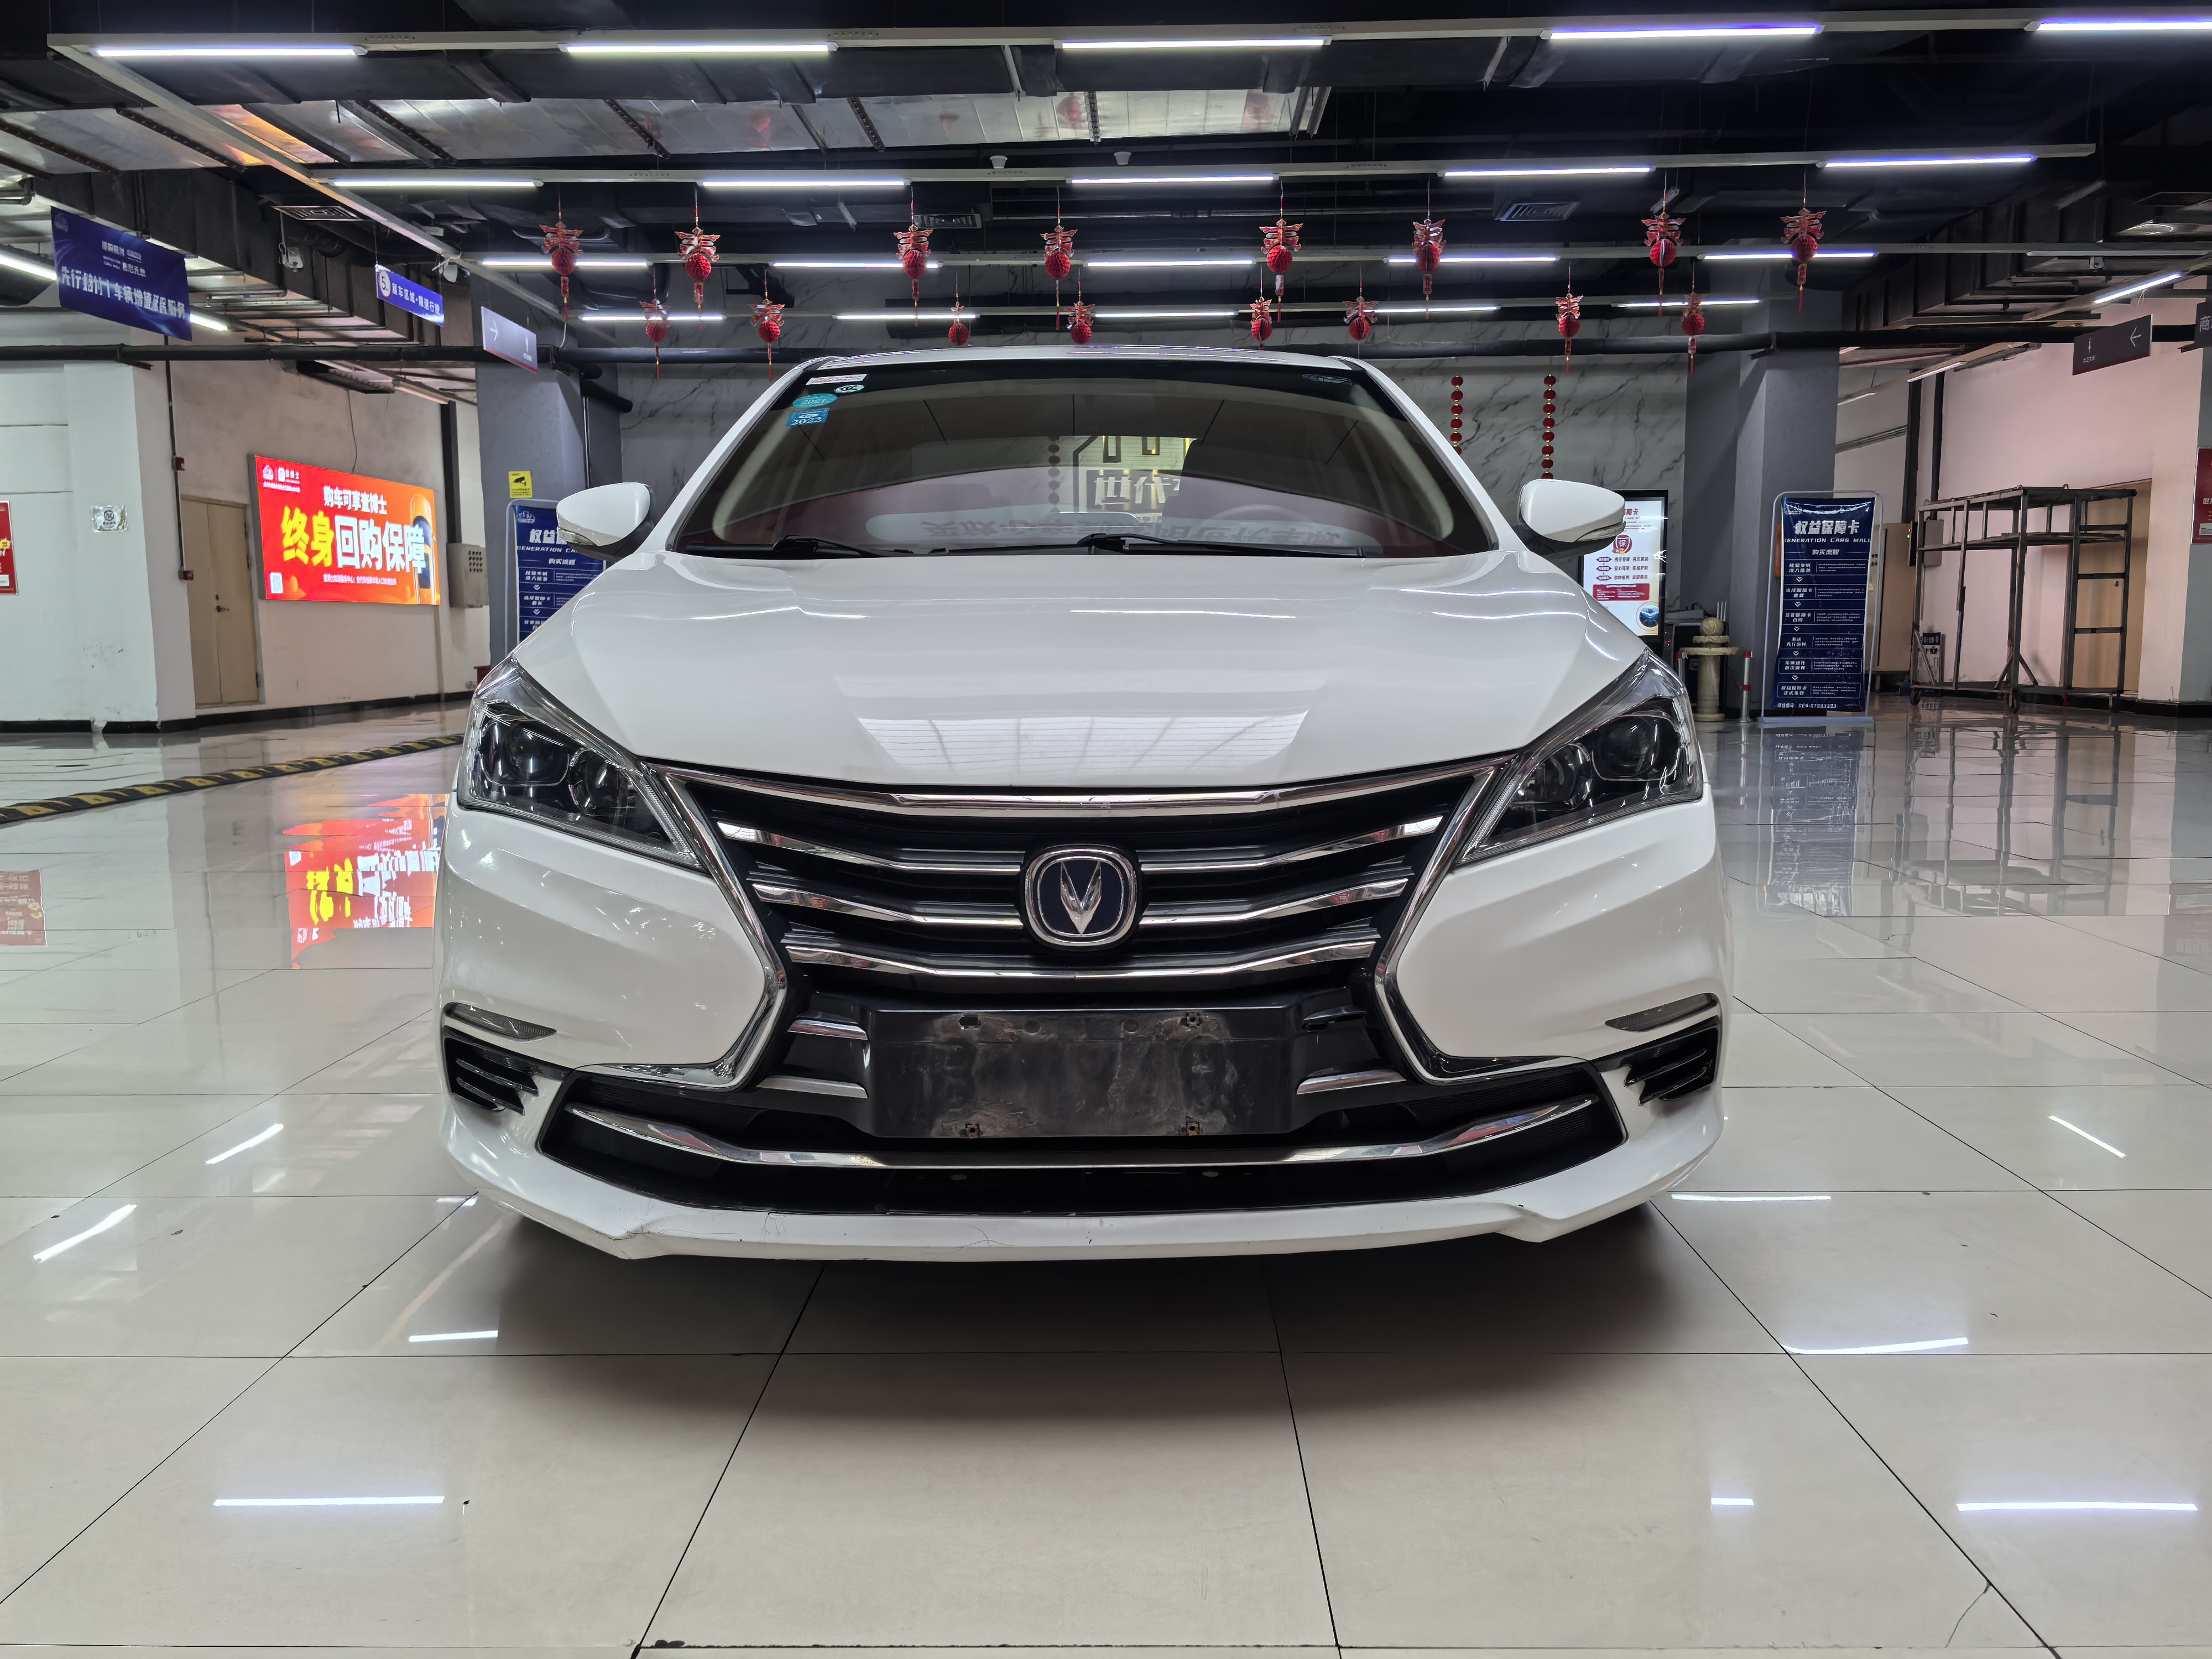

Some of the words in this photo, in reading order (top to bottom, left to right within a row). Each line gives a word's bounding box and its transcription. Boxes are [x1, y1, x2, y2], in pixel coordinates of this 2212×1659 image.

[2199, 315, 2212, 333] 商
[790, 416, 822, 426] 2022
[323, 485, 387, 515] 购车可享查博士
[1794, 520, 1860, 535] 权益保障卡
[281, 505, 426, 574] 终身回购保障
